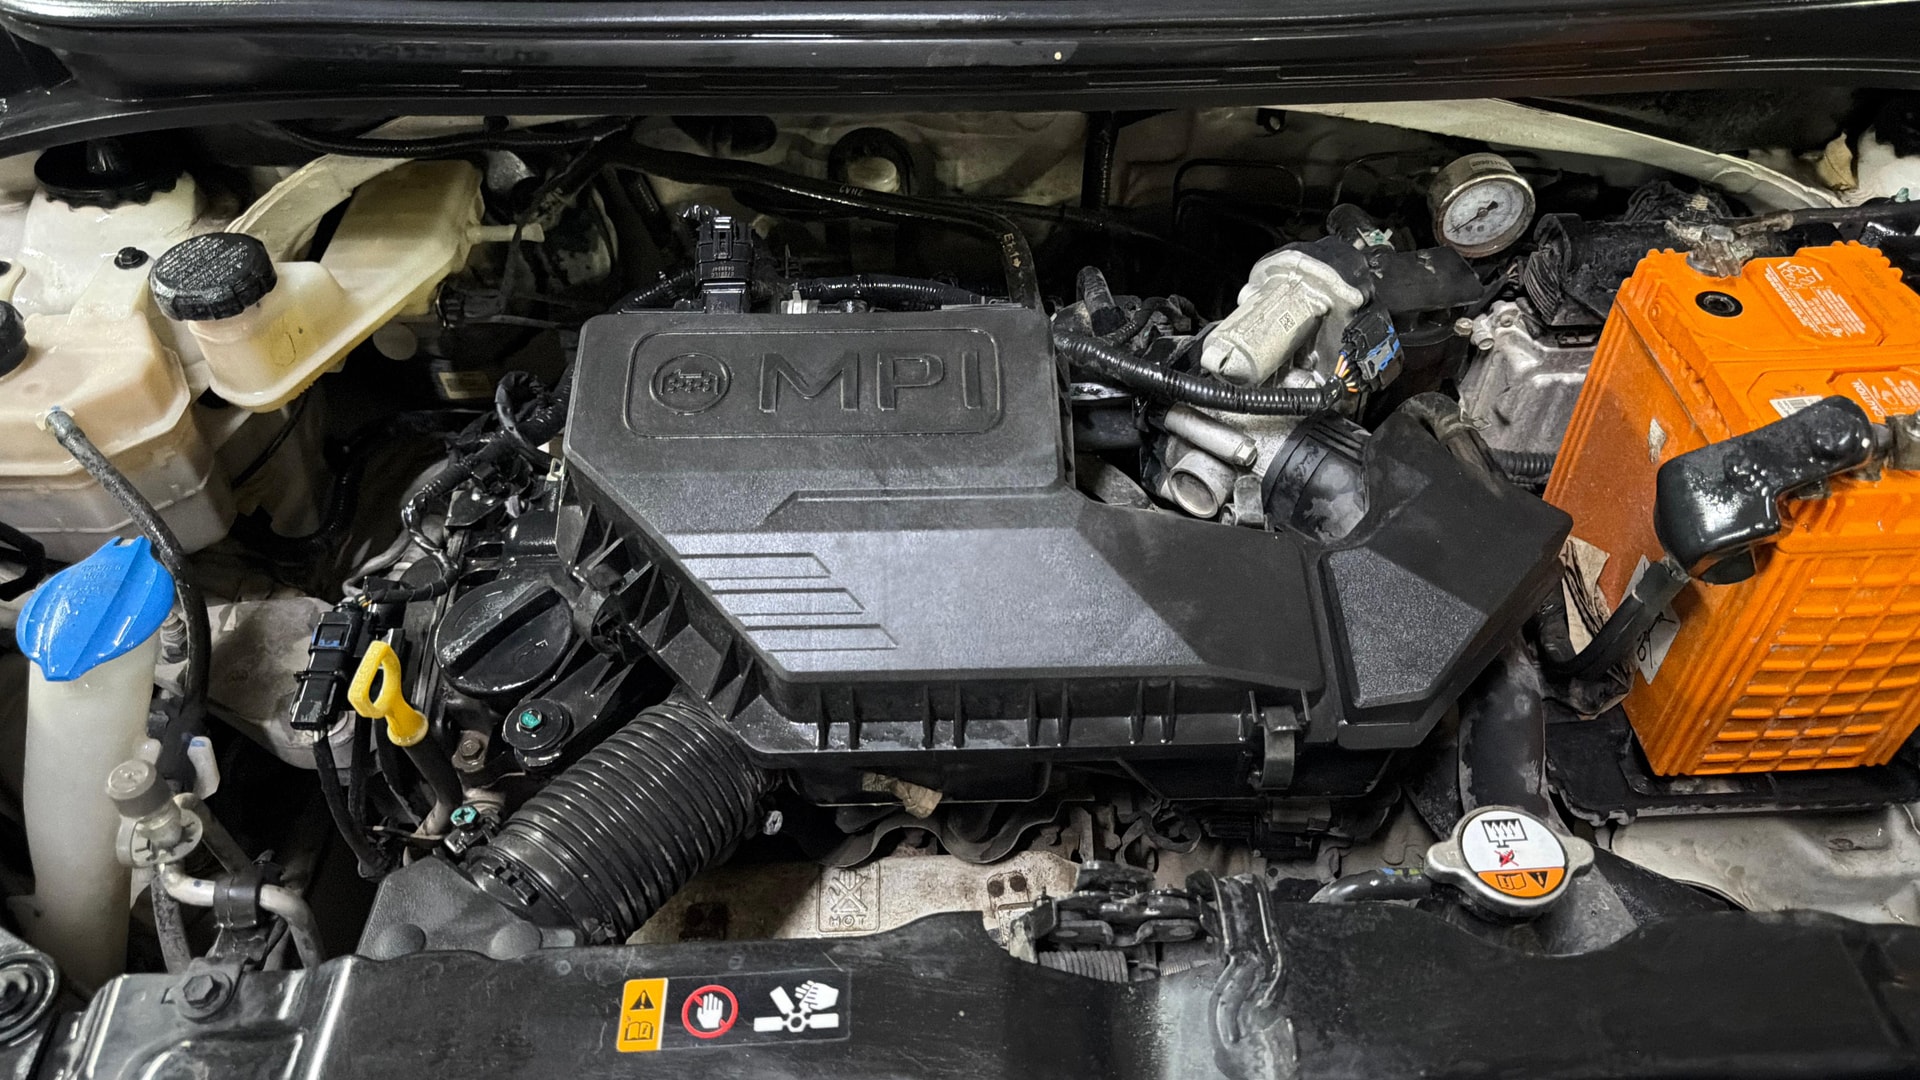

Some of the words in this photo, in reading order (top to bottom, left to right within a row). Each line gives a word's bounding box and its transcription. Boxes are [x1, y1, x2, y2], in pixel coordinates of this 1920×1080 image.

[759, 351, 982, 413] MPI
[1851, 381, 1886, 418] CAUTION
[829, 914, 867, 927] HOT
